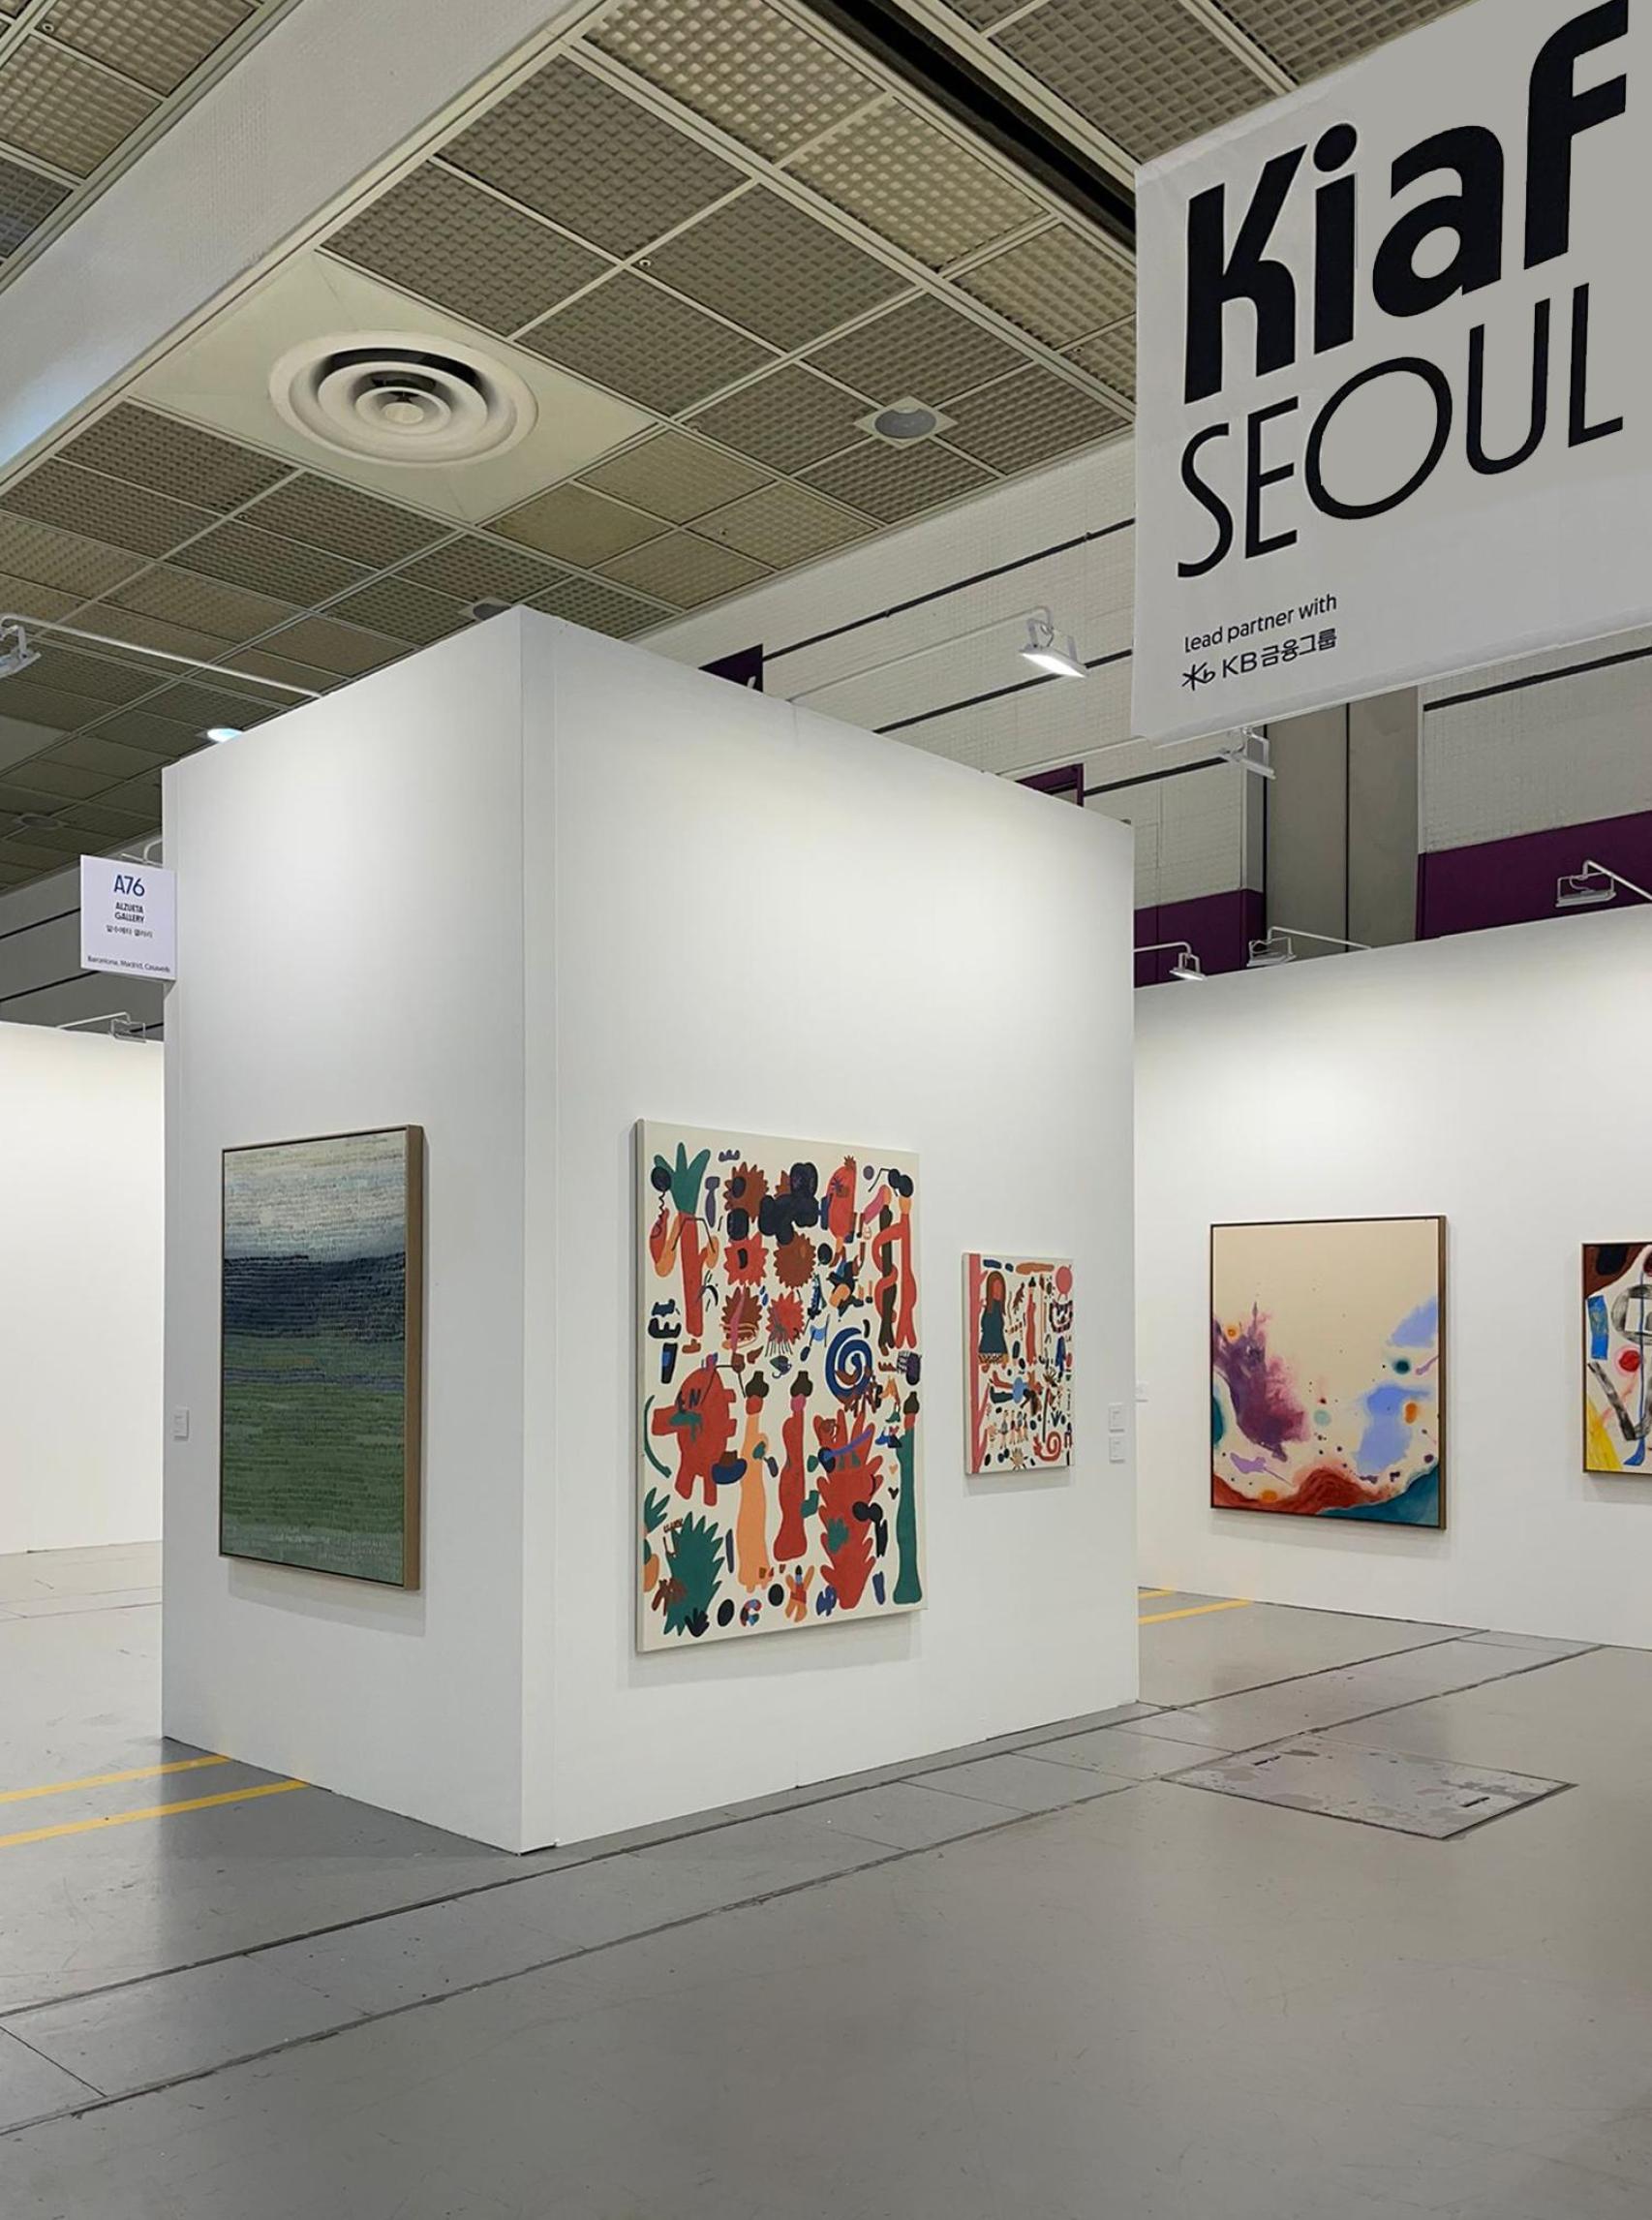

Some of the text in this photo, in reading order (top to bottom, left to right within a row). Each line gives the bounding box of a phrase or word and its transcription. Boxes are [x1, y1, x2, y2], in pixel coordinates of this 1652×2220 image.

[1184, 0, 1628, 405] Kiaf
[1178, 283, 1623, 578] SEOUL
[1185, 594, 1336, 653] lead partner with
[113, 875, 145, 897] A76
[114, 911, 144, 924] GALLERY
